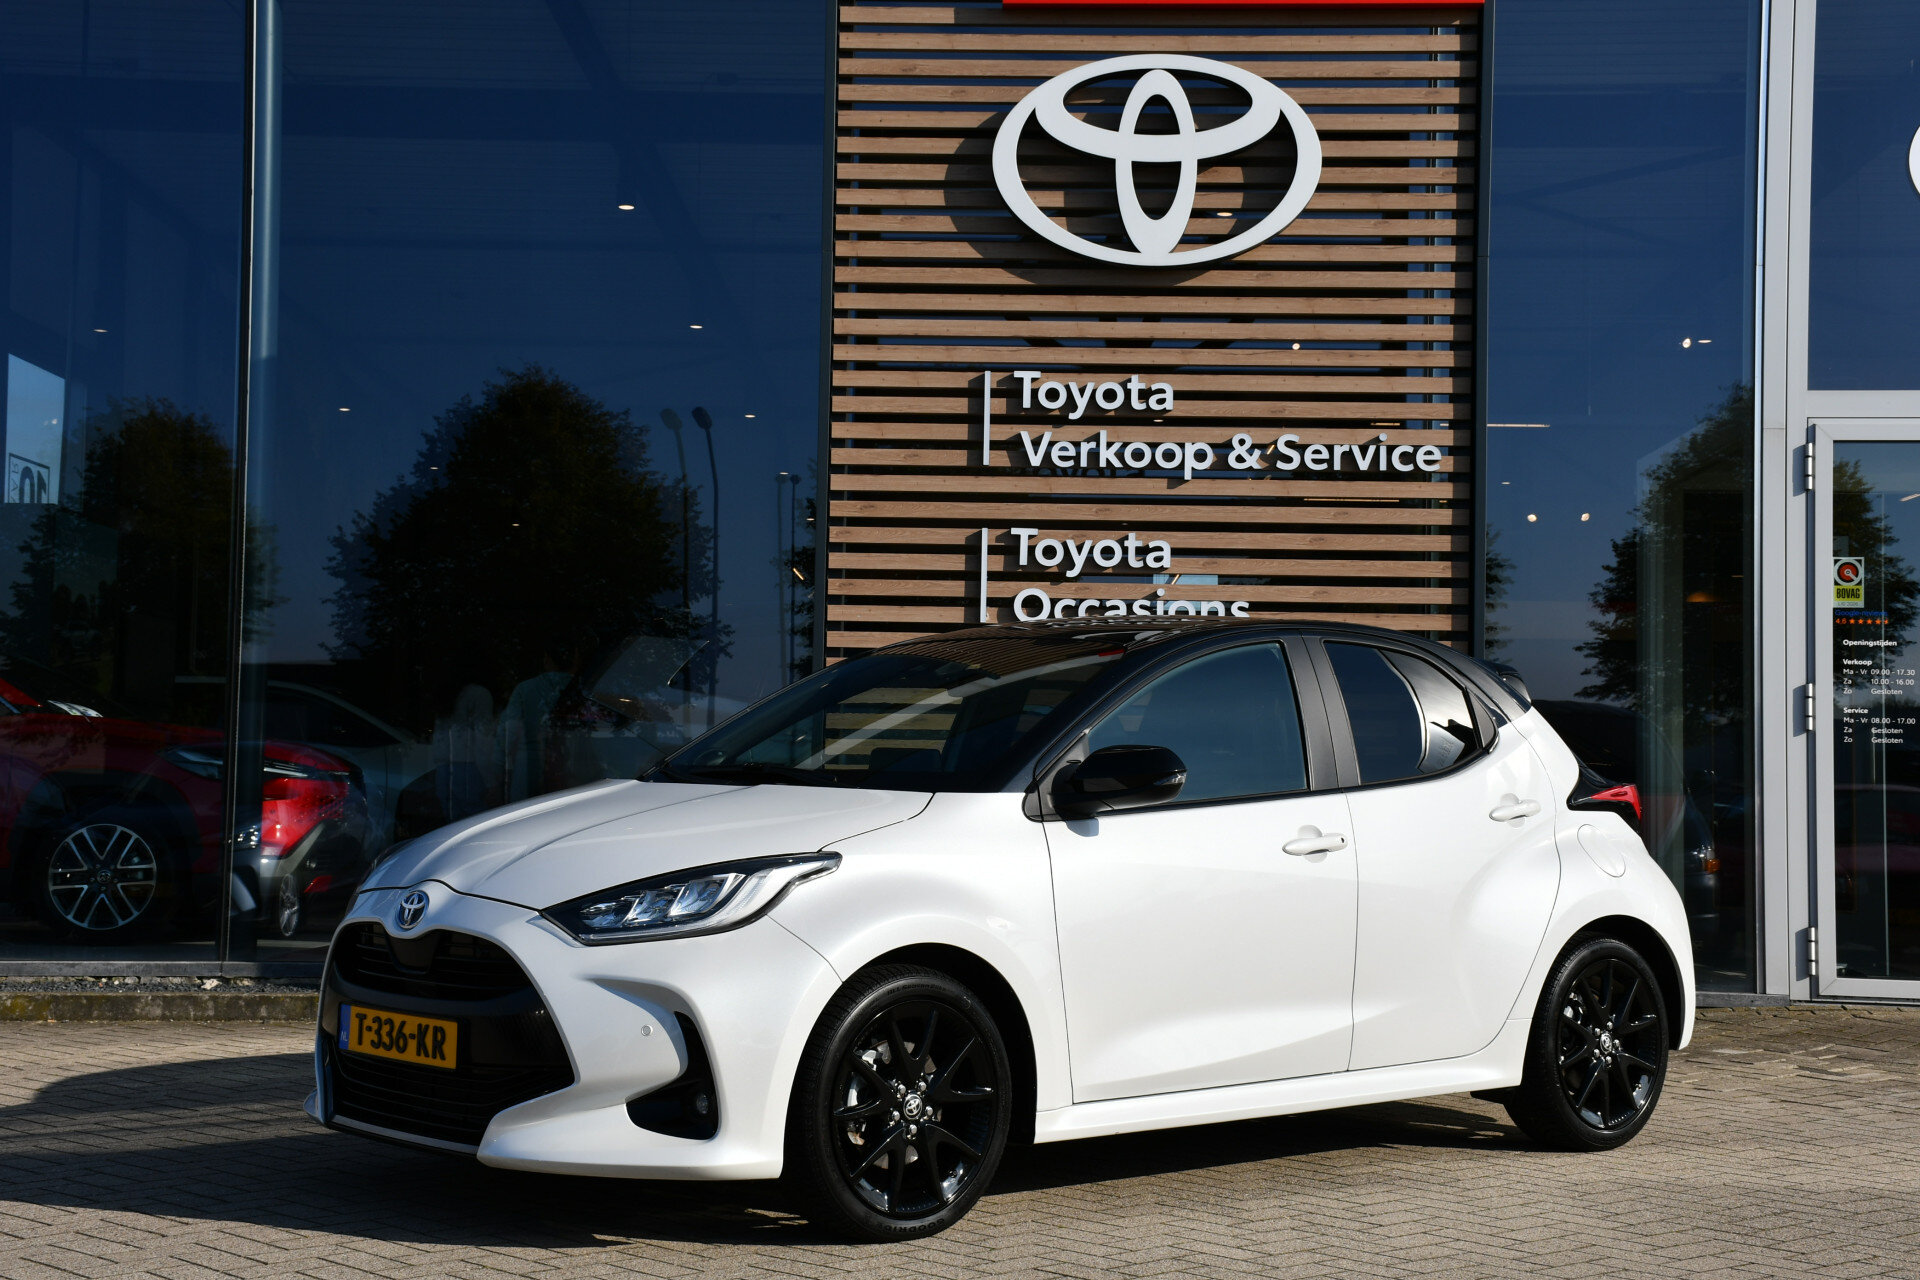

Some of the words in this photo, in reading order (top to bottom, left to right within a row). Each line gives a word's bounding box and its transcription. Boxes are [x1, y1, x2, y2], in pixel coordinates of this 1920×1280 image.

[1014, 371, 1174, 419] Toyota
[1020, 430, 1213, 480] Verkoop
[1228, 433, 1262, 470] &
[1276, 433, 1442, 472] Service
[1011, 528, 1171, 577] Toyota
[1013, 588, 1250, 621] Occasions
[1836, 588, 1860, 599] BOVAG
[1843, 639, 1897, 648] Openingstijden
[355, 1012, 446, 1061] T-336-KR
